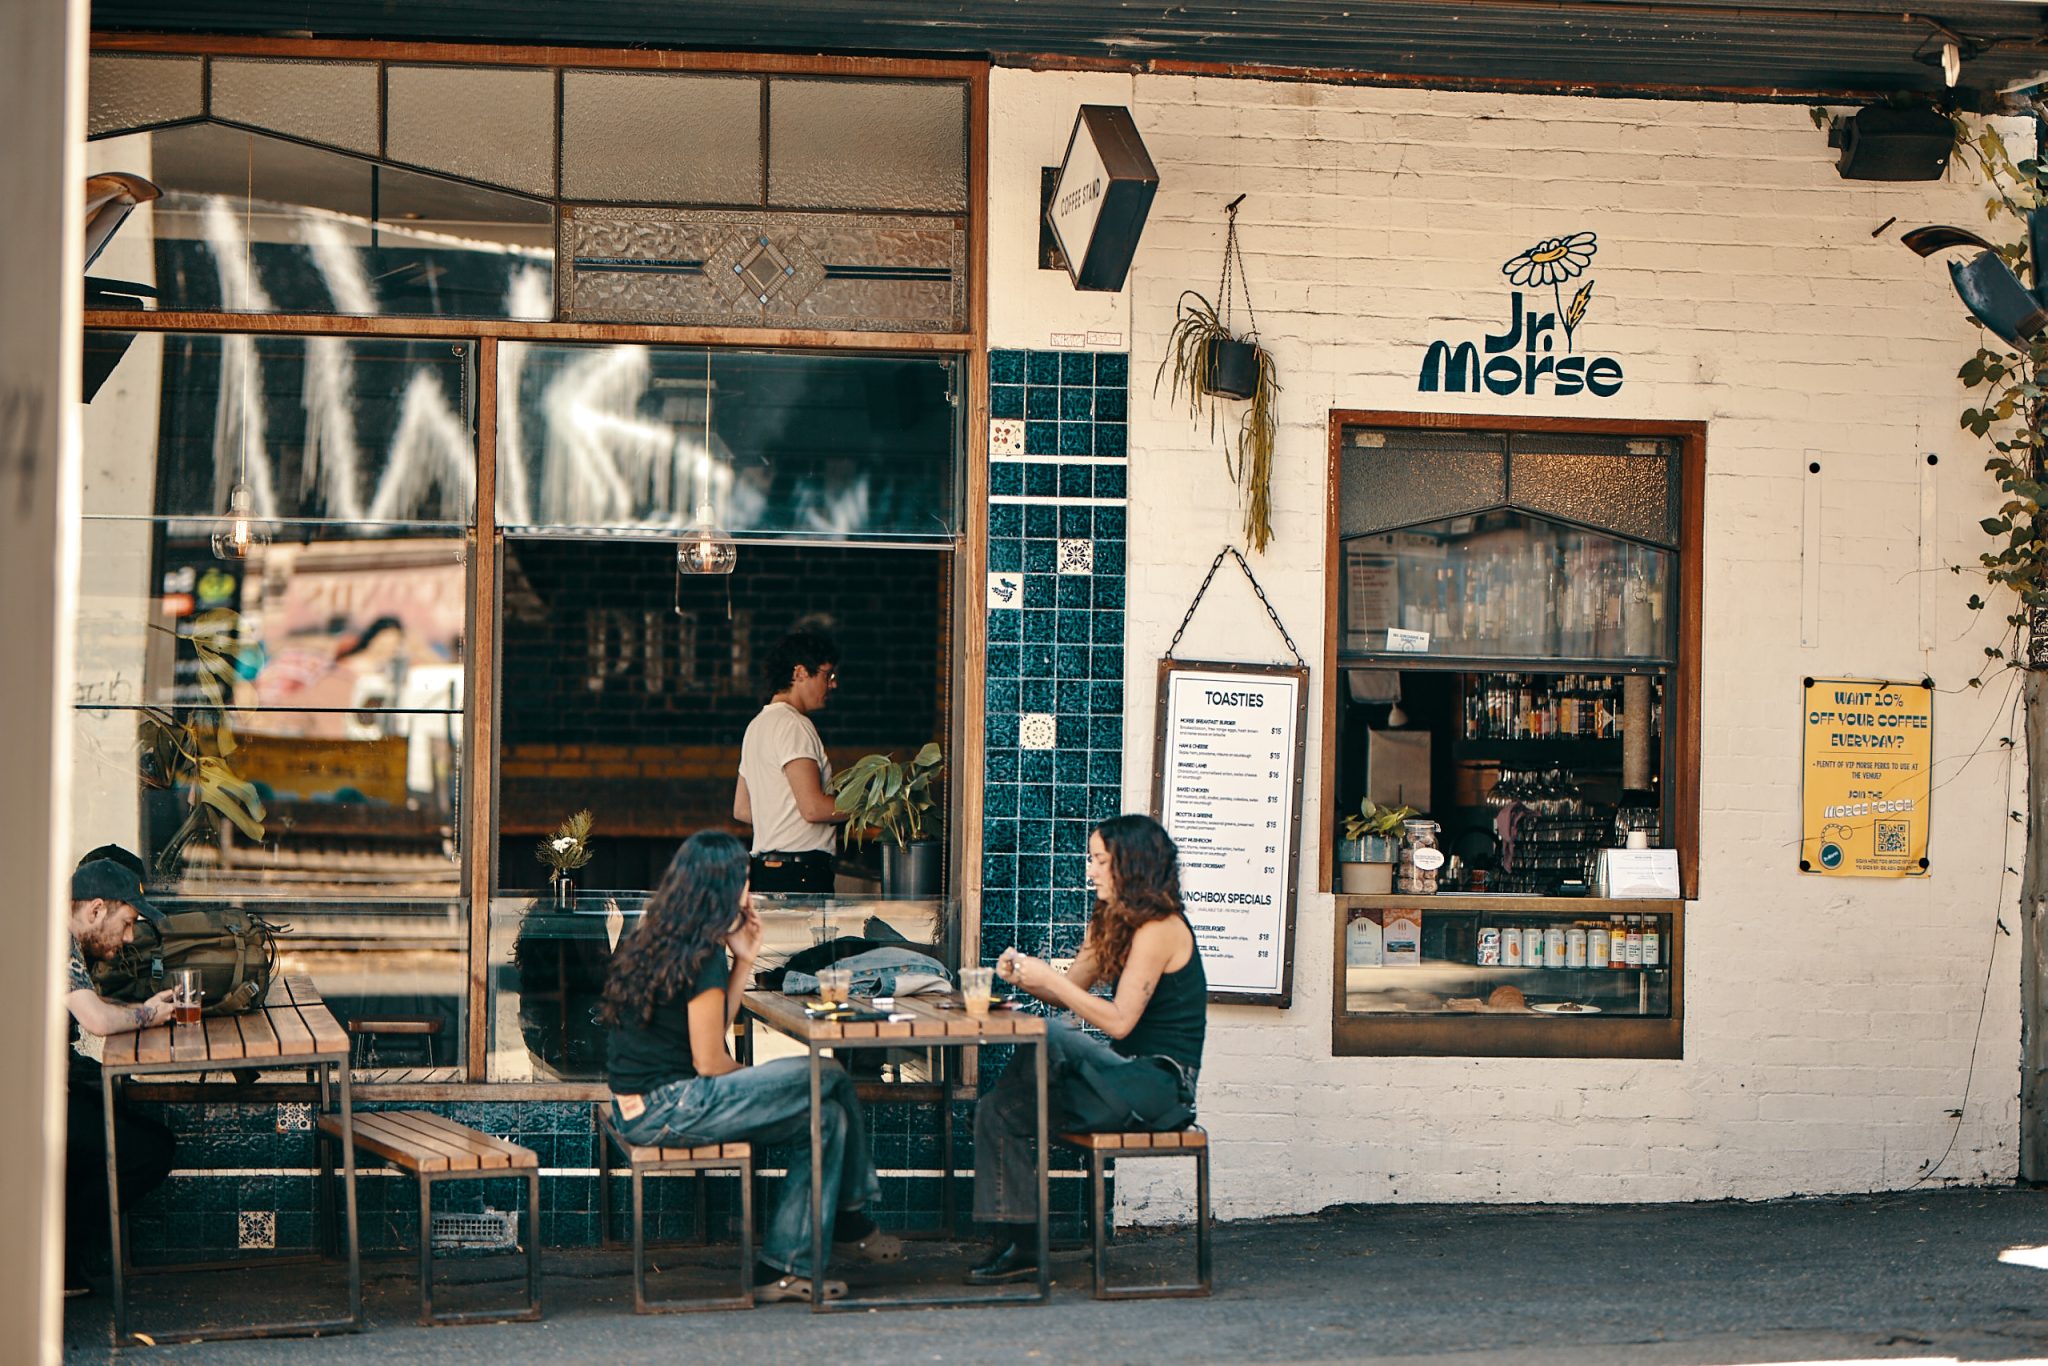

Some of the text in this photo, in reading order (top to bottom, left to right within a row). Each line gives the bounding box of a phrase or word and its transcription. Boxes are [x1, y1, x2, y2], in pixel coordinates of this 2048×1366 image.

[1061, 178, 1100, 217] COFFEE STAND
[1205, 691, 1263, 708] TOASTIES
[1835, 691, 1903, 707] WANT 10%
[1809, 712, 1927, 728] OFF YOUR COFFEE
[1832, 733, 1904, 748] EVERYDAY?
[1868, 791, 1882, 799] THE
[1182, 891, 1272, 905] UNCHBOX SPECIALS
